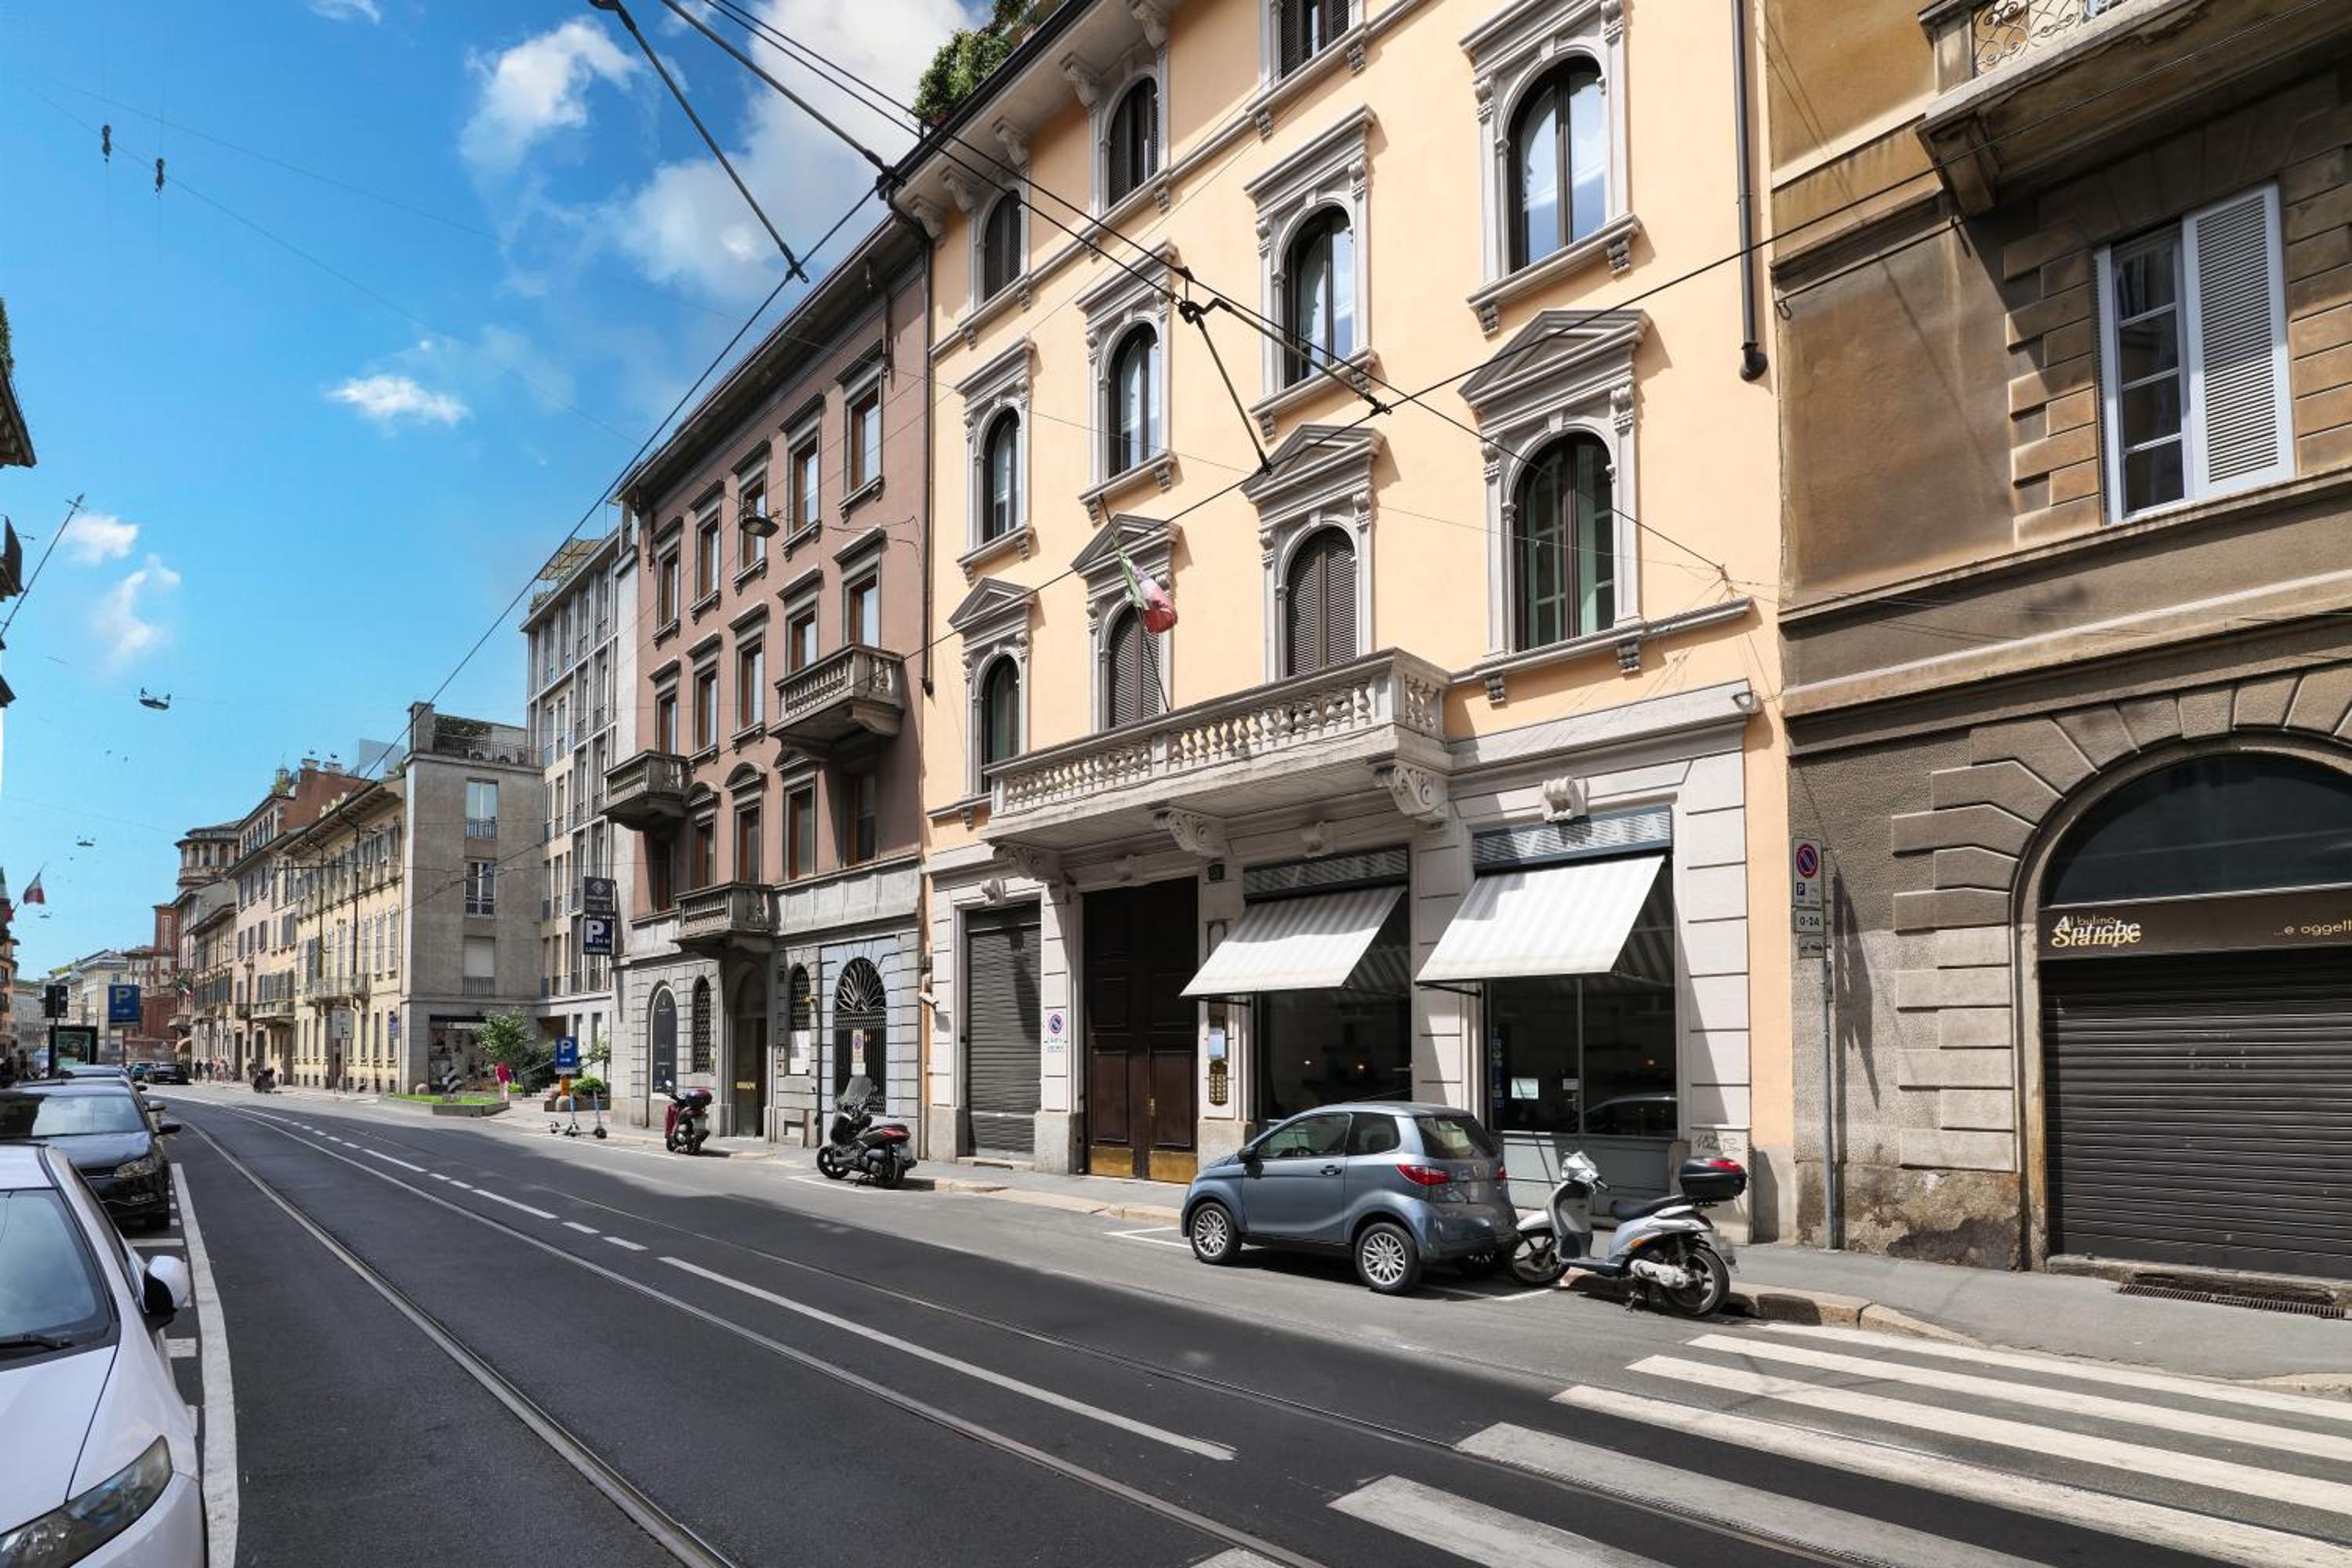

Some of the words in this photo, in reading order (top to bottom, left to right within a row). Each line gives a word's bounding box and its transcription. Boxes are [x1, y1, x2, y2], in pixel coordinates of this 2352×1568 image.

[2077, 914, 2116, 925] bulino
[586, 920, 604, 943] P
[2051, 928, 2141, 948] Stampe
[115, 987, 131, 1004] P
[561, 1040, 572, 1054] P
